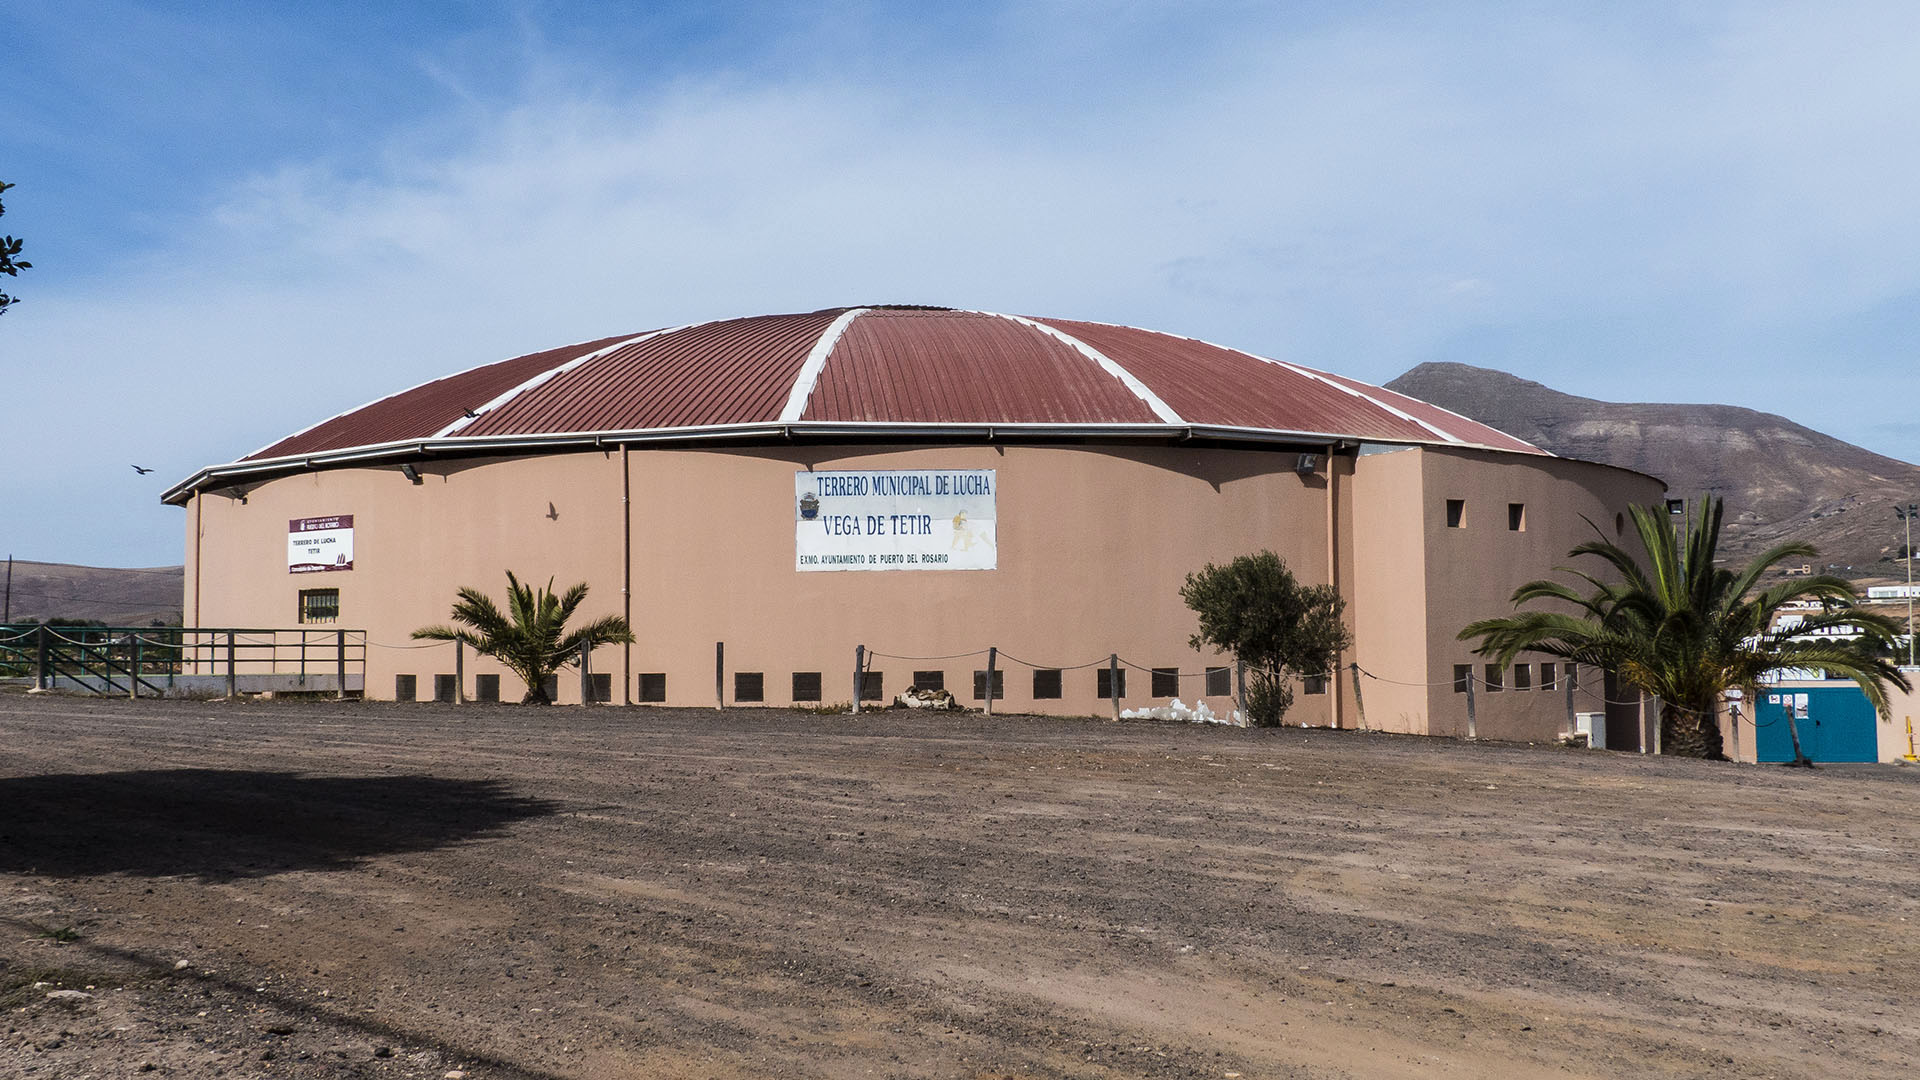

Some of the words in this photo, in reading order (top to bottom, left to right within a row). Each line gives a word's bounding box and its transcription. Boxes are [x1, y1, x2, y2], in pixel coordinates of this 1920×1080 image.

[817, 476, 868, 497] TERRERO
[872, 475, 932, 496] MUNICIPAL
[935, 475, 950, 495] DE
[953, 474, 990, 495] LUCHA
[823, 515, 861, 536] VEGA
[867, 515, 885, 535] DE
[890, 514, 932, 535] TETIR
[800, 555, 819, 564] EXMO.
[821, 555, 865, 564] AYUNTAMIENTO
[868, 554, 877, 564] DE
[880, 554, 904, 564] PUERTO
[907, 554, 918, 564] DEL
[922, 554, 948, 563] ROSARIO
